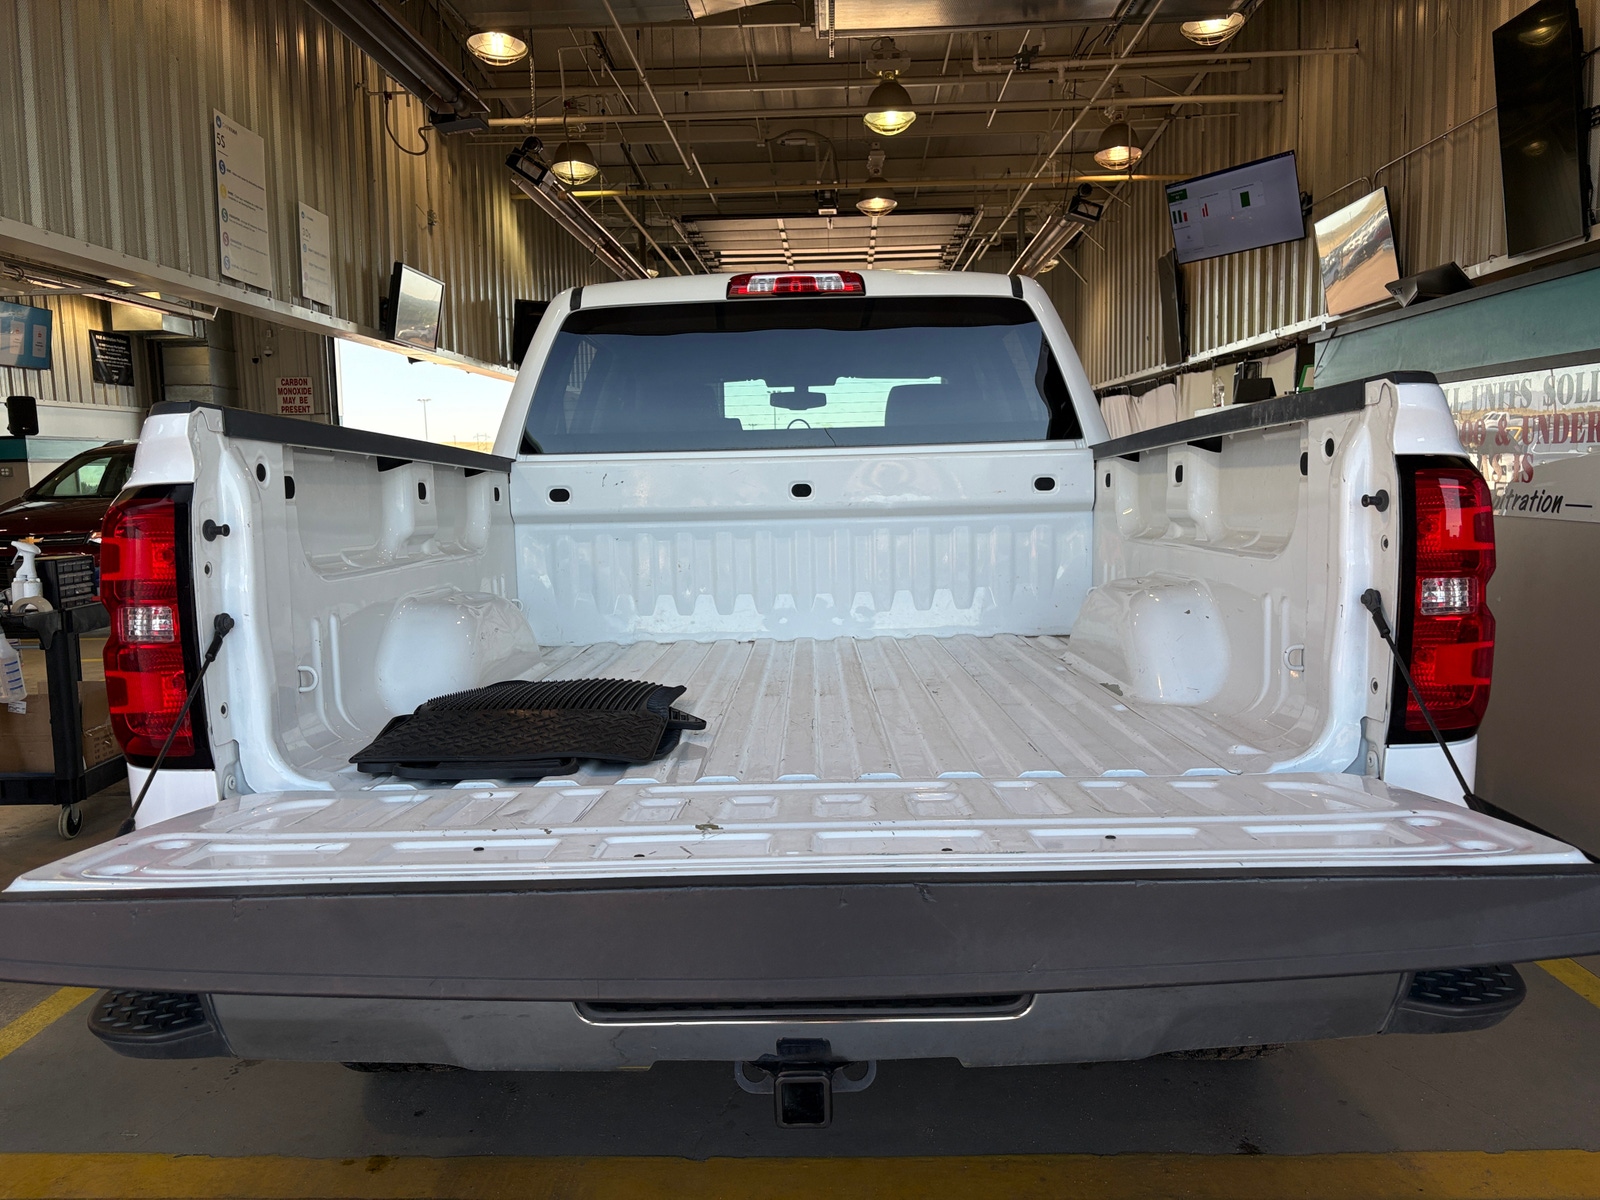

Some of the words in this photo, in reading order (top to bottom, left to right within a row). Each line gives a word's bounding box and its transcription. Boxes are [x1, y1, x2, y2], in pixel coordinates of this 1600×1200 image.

[216, 132, 226, 148] 5S
[281, 378, 307, 386] CARBON
[1472, 378, 1532, 412] UNITS
[1495, 414, 1512, 446] &
[1521, 411, 1600, 446] UNDER
[1480, 453, 1504, 483] AS
[1513, 452, 1534, 484] IS
